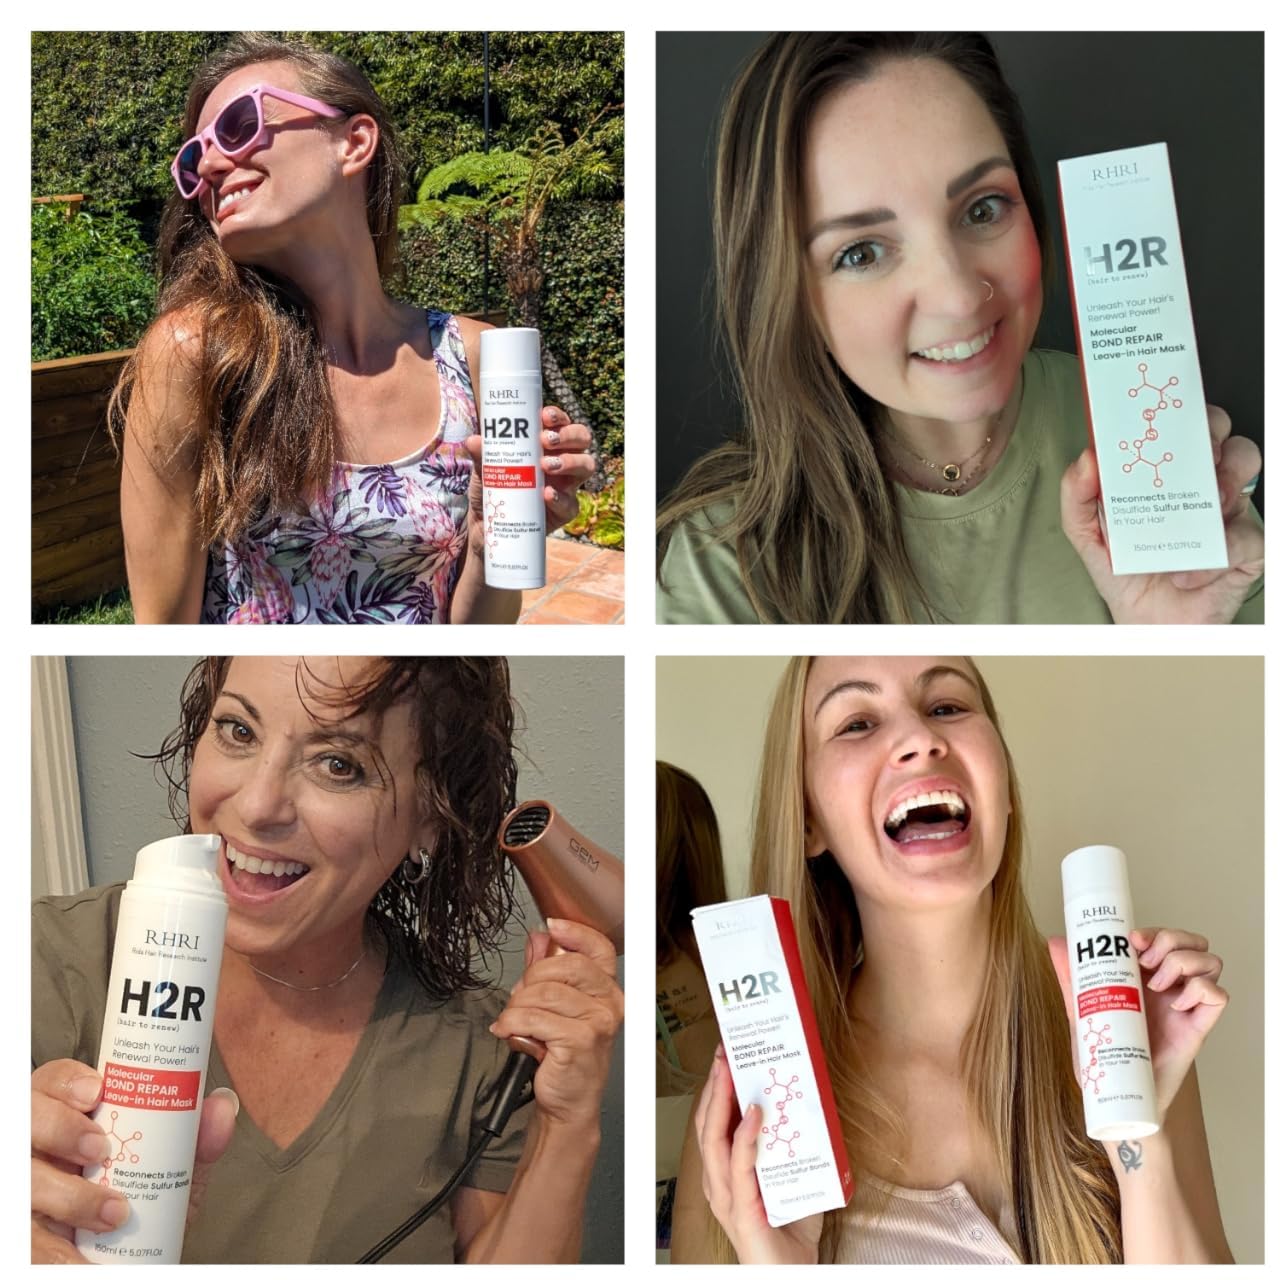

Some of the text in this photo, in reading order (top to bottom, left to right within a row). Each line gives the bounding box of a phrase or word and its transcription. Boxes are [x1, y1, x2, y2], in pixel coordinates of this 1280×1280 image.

[1092, 163, 1139, 181] RHRI
[1083, 236, 1169, 276] H2R
[1090, 325, 1137, 336] Molecular
[1092, 333, 1163, 349] BOND REPAIR
[1093, 344, 1185, 361] Leave-in Hair Mask
[489, 389, 520, 400] RHRI
[483, 417, 529, 439] H2R
[1153, 501, 1213, 511] Sulfur Bonds
[1082, 906, 1117, 919] RHRI
[144, 929, 200, 950] RHRI
[1077, 934, 1131, 964] H2R
[718, 971, 782, 1006] H2R
[121, 978, 205, 1022] H2R
[114, 1036, 176, 1053] Unleash Your
[735, 1044, 785, 1061] BOND REPAIR
[112, 1049, 187, 1066] Renewal Power!
[783, 1051, 801, 1059] Mask
[108, 1067, 154, 1081] Molecular
[106, 1078, 178, 1095] BOND REPAIR
[114, 1168, 164, 1179] Reconnects
